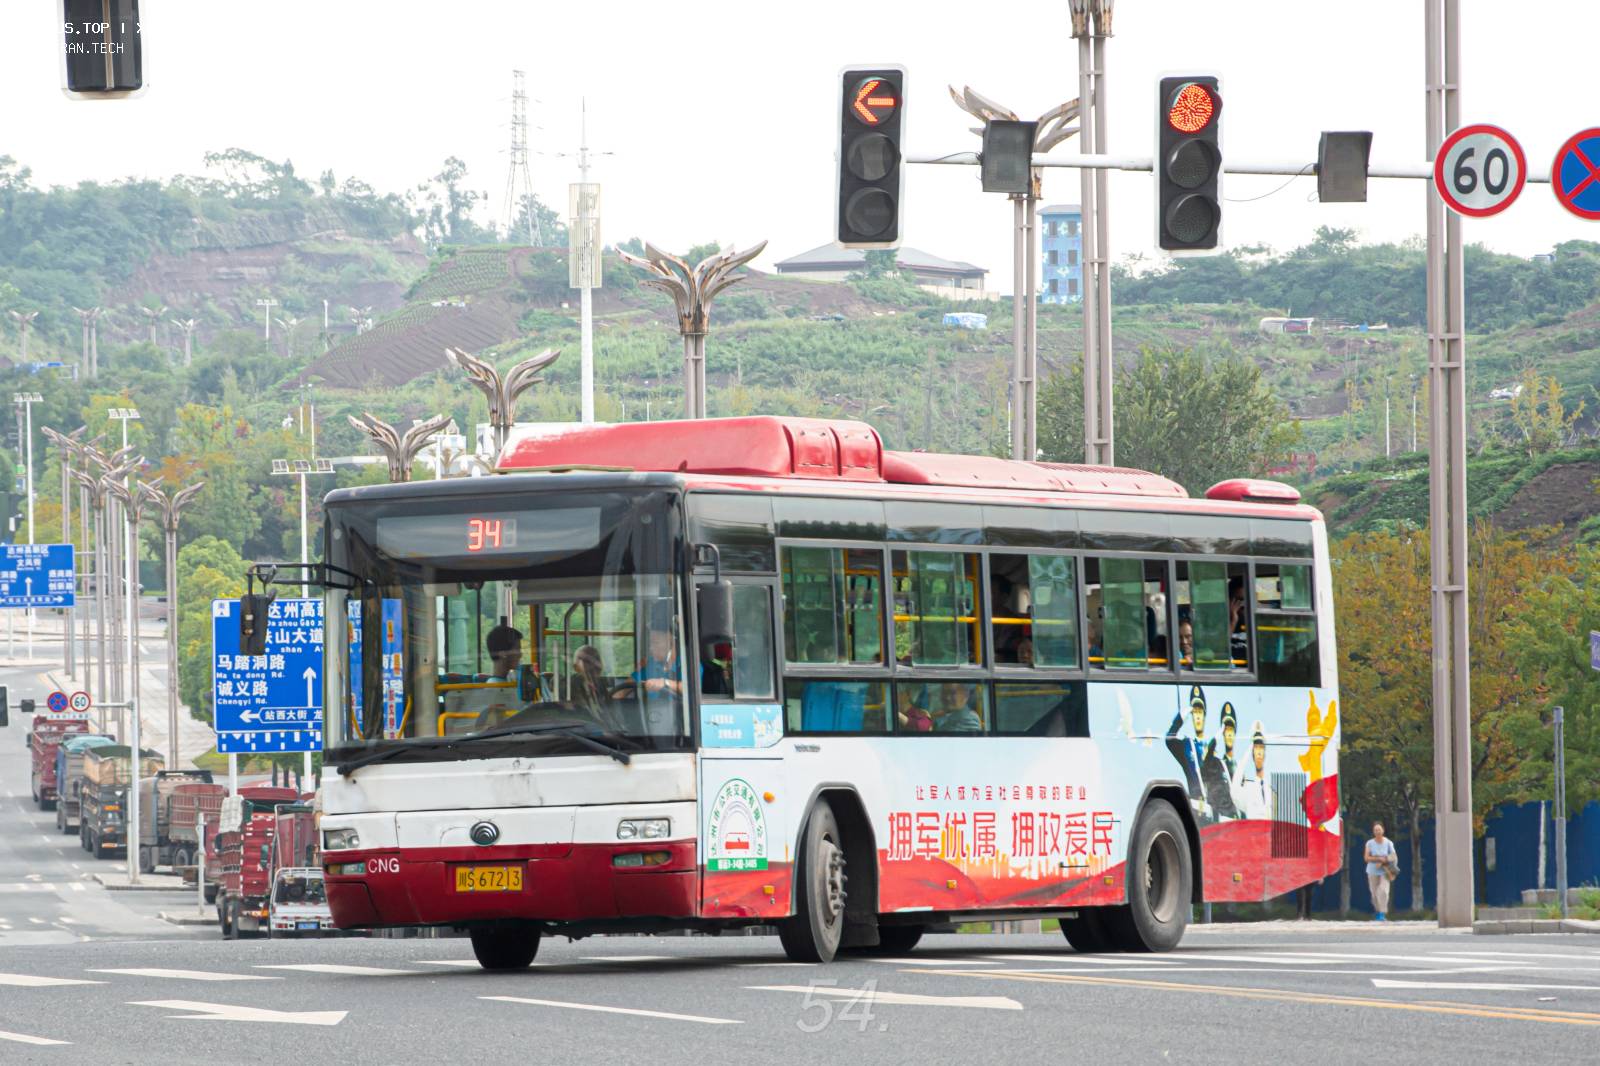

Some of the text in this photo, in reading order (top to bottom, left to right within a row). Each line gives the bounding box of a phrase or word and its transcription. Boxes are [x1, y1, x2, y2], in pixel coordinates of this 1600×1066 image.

[1453, 147, 1510, 195] 60
[467, 518, 501, 551] 34
[217, 653, 286, 671] 马踏洞路
[217, 680, 269, 697] 诚义路
[74, 696, 87, 707] 60
[265, 709, 307, 720] 站西大街
[887, 811, 1114, 859] 拥军优属 拥政爱民
[367, 857, 400, 873] CNG
